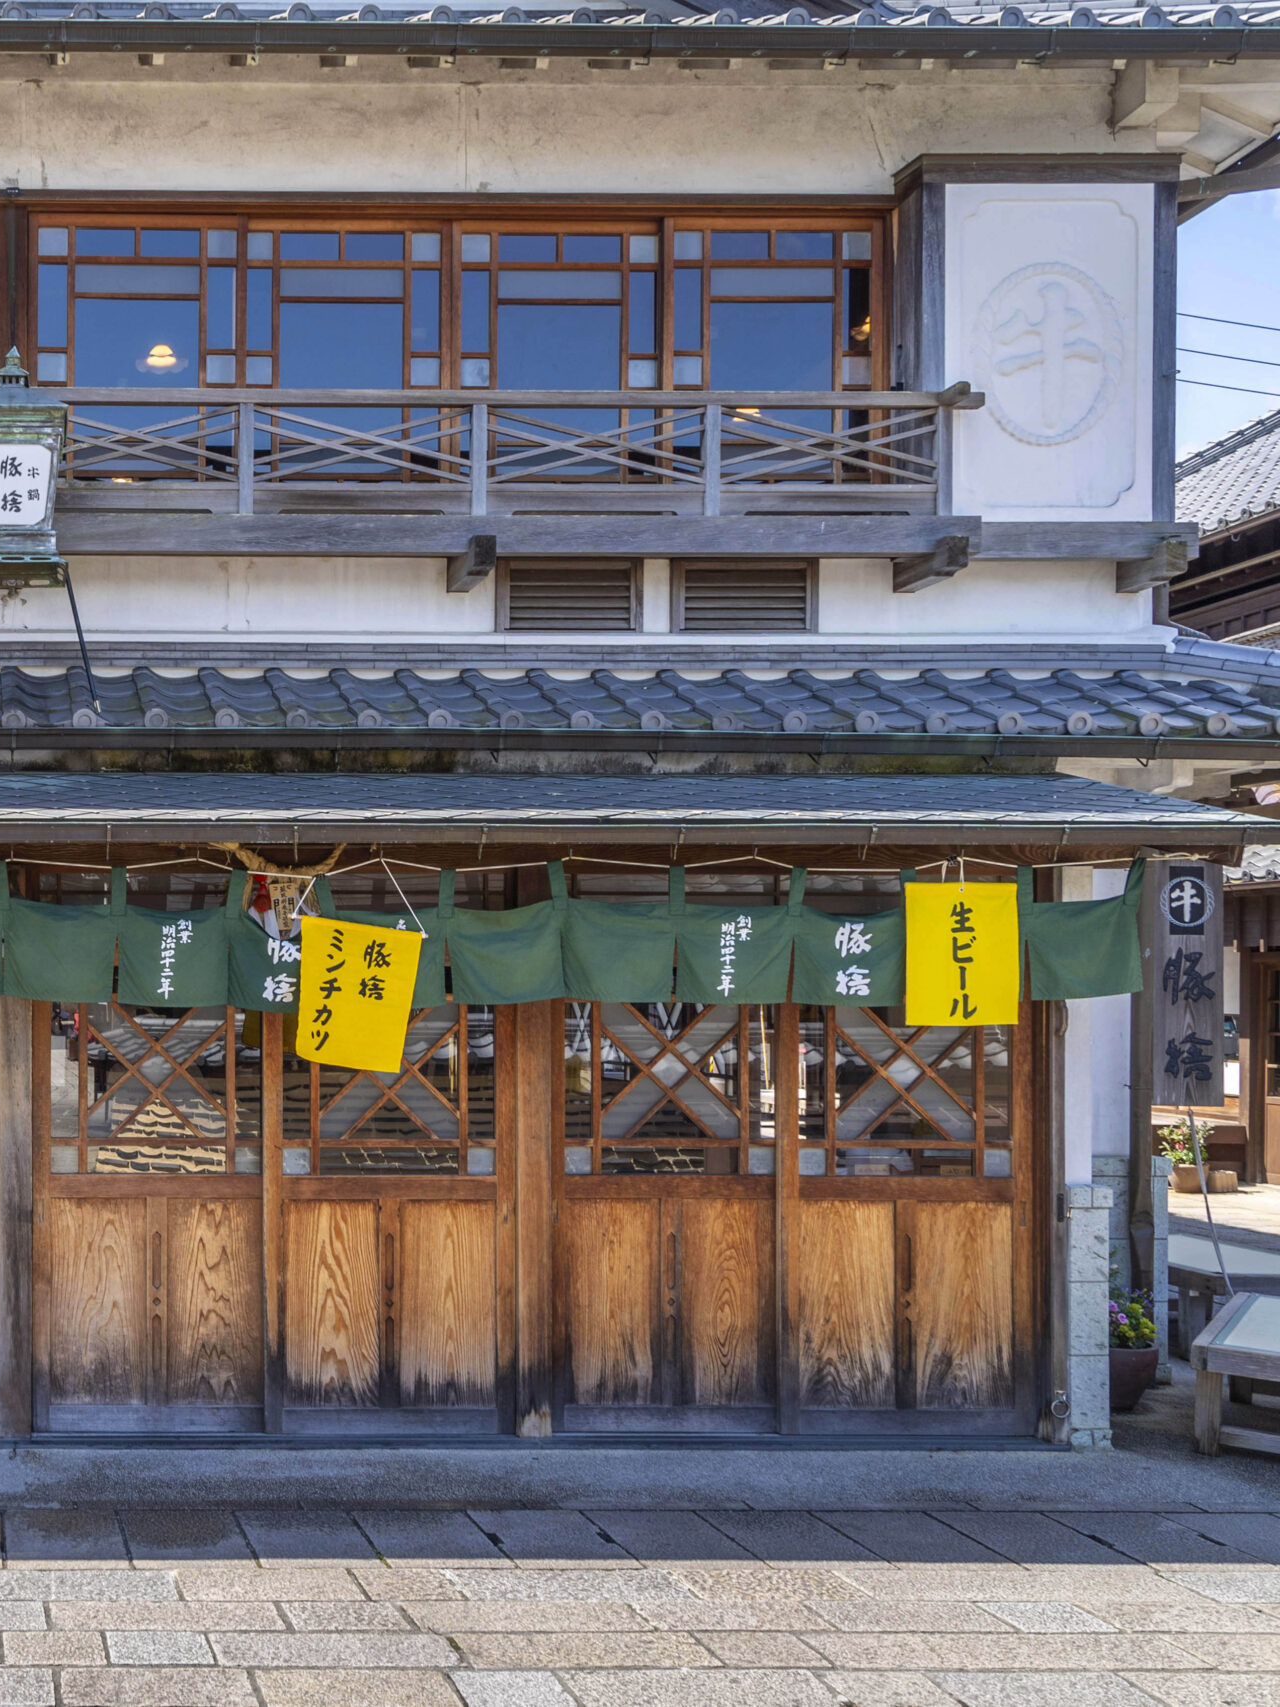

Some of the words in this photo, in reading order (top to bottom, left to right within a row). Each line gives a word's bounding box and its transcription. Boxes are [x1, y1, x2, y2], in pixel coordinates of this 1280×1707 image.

[995, 282, 1101, 429] 牛
[0, 455, 23, 513] 豚捨
[177, 919, 194, 944] 創業
[736, 914, 753, 942] 創業
[1171, 881, 1202, 923] 牛
[157, 924, 176, 1000] 明治四十二年
[262, 937, 301, 1003] 豚捨
[311, 928, 346, 1051] ミンチカツ
[358, 939, 392, 1001] 豚捨
[716, 921, 736, 997] 明治四十二年
[834, 921, 873, 996] 豚捨
[949, 901, 978, 1020] 生ビール
[1162, 946, 1216, 1081] 豚捨
